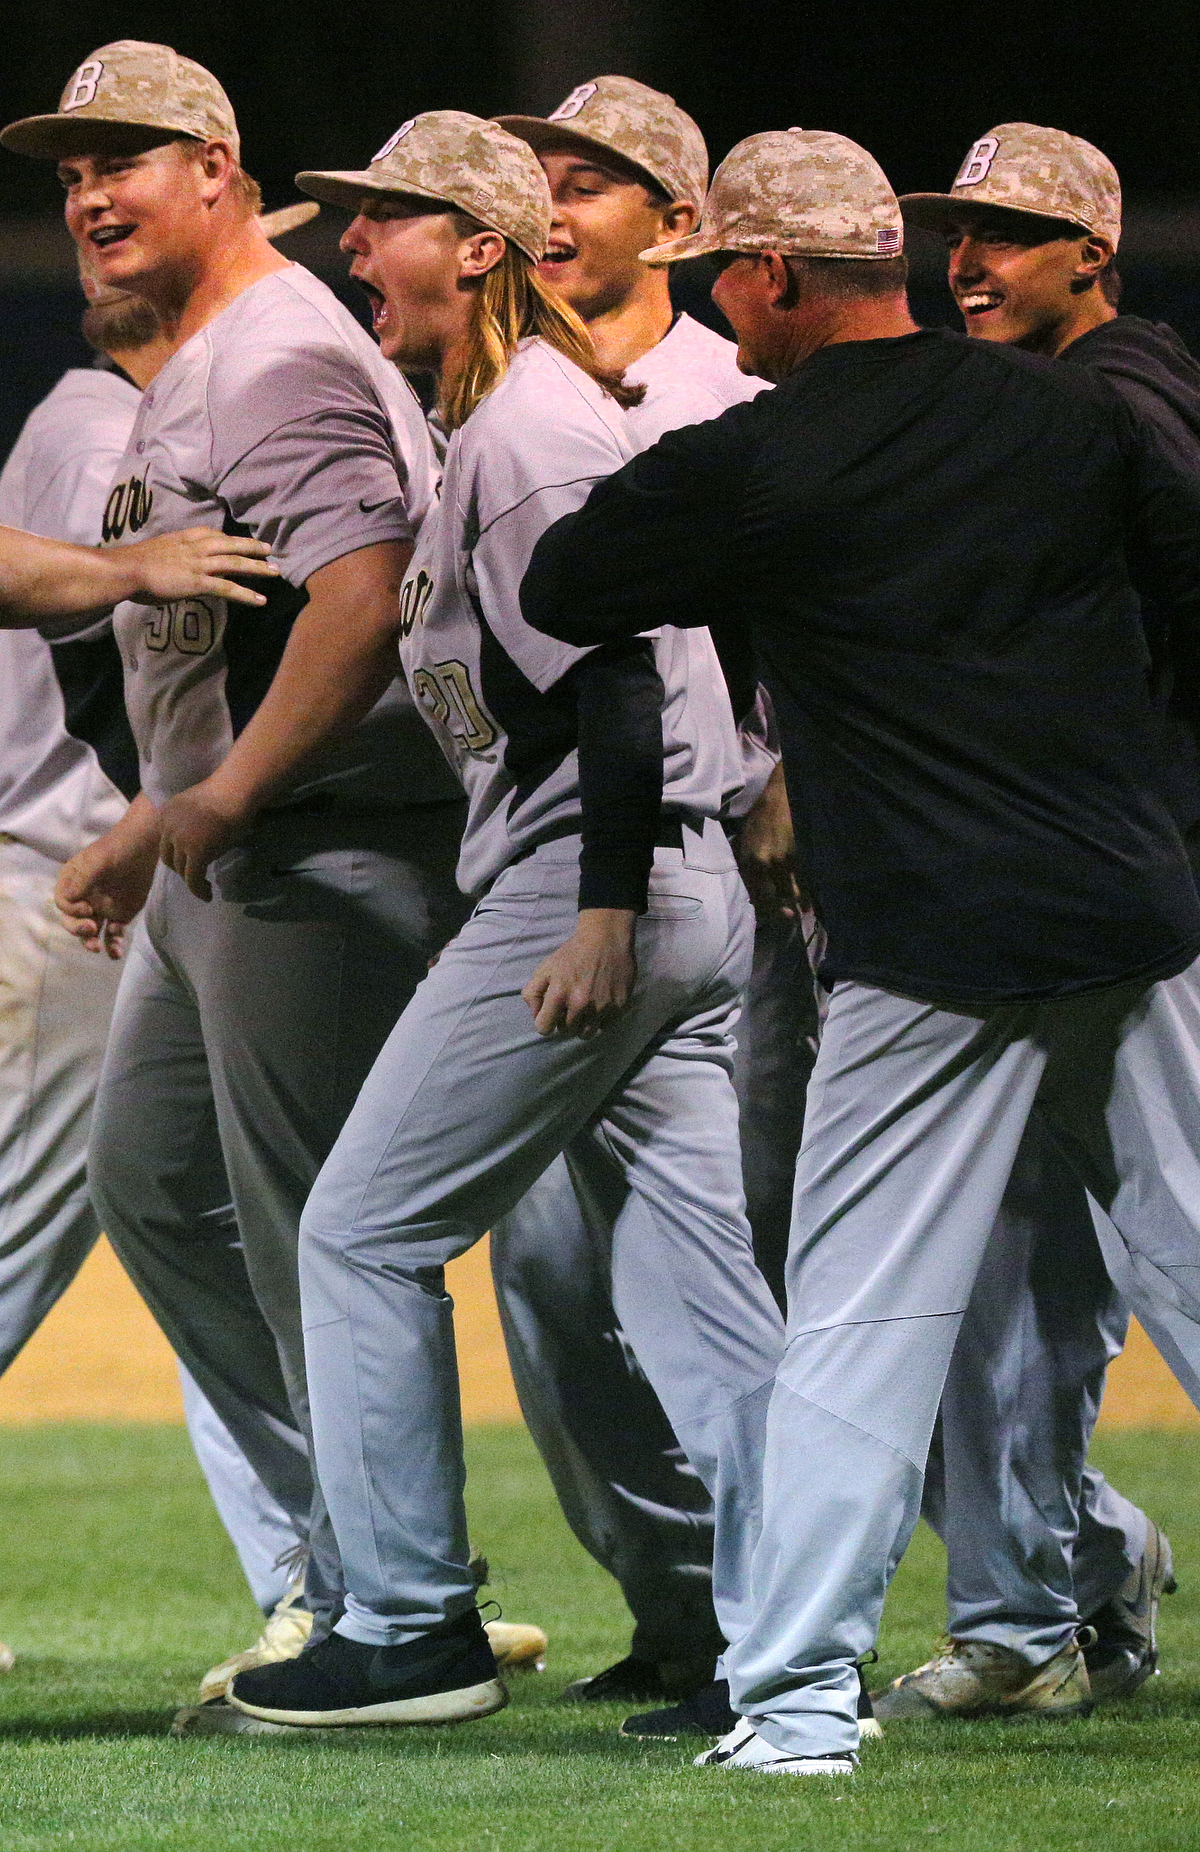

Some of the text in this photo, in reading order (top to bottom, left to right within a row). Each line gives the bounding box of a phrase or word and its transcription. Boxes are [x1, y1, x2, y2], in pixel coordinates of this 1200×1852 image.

[63, 60, 104, 113] B
[547, 83, 598, 121] B
[956, 137, 1000, 188] B
